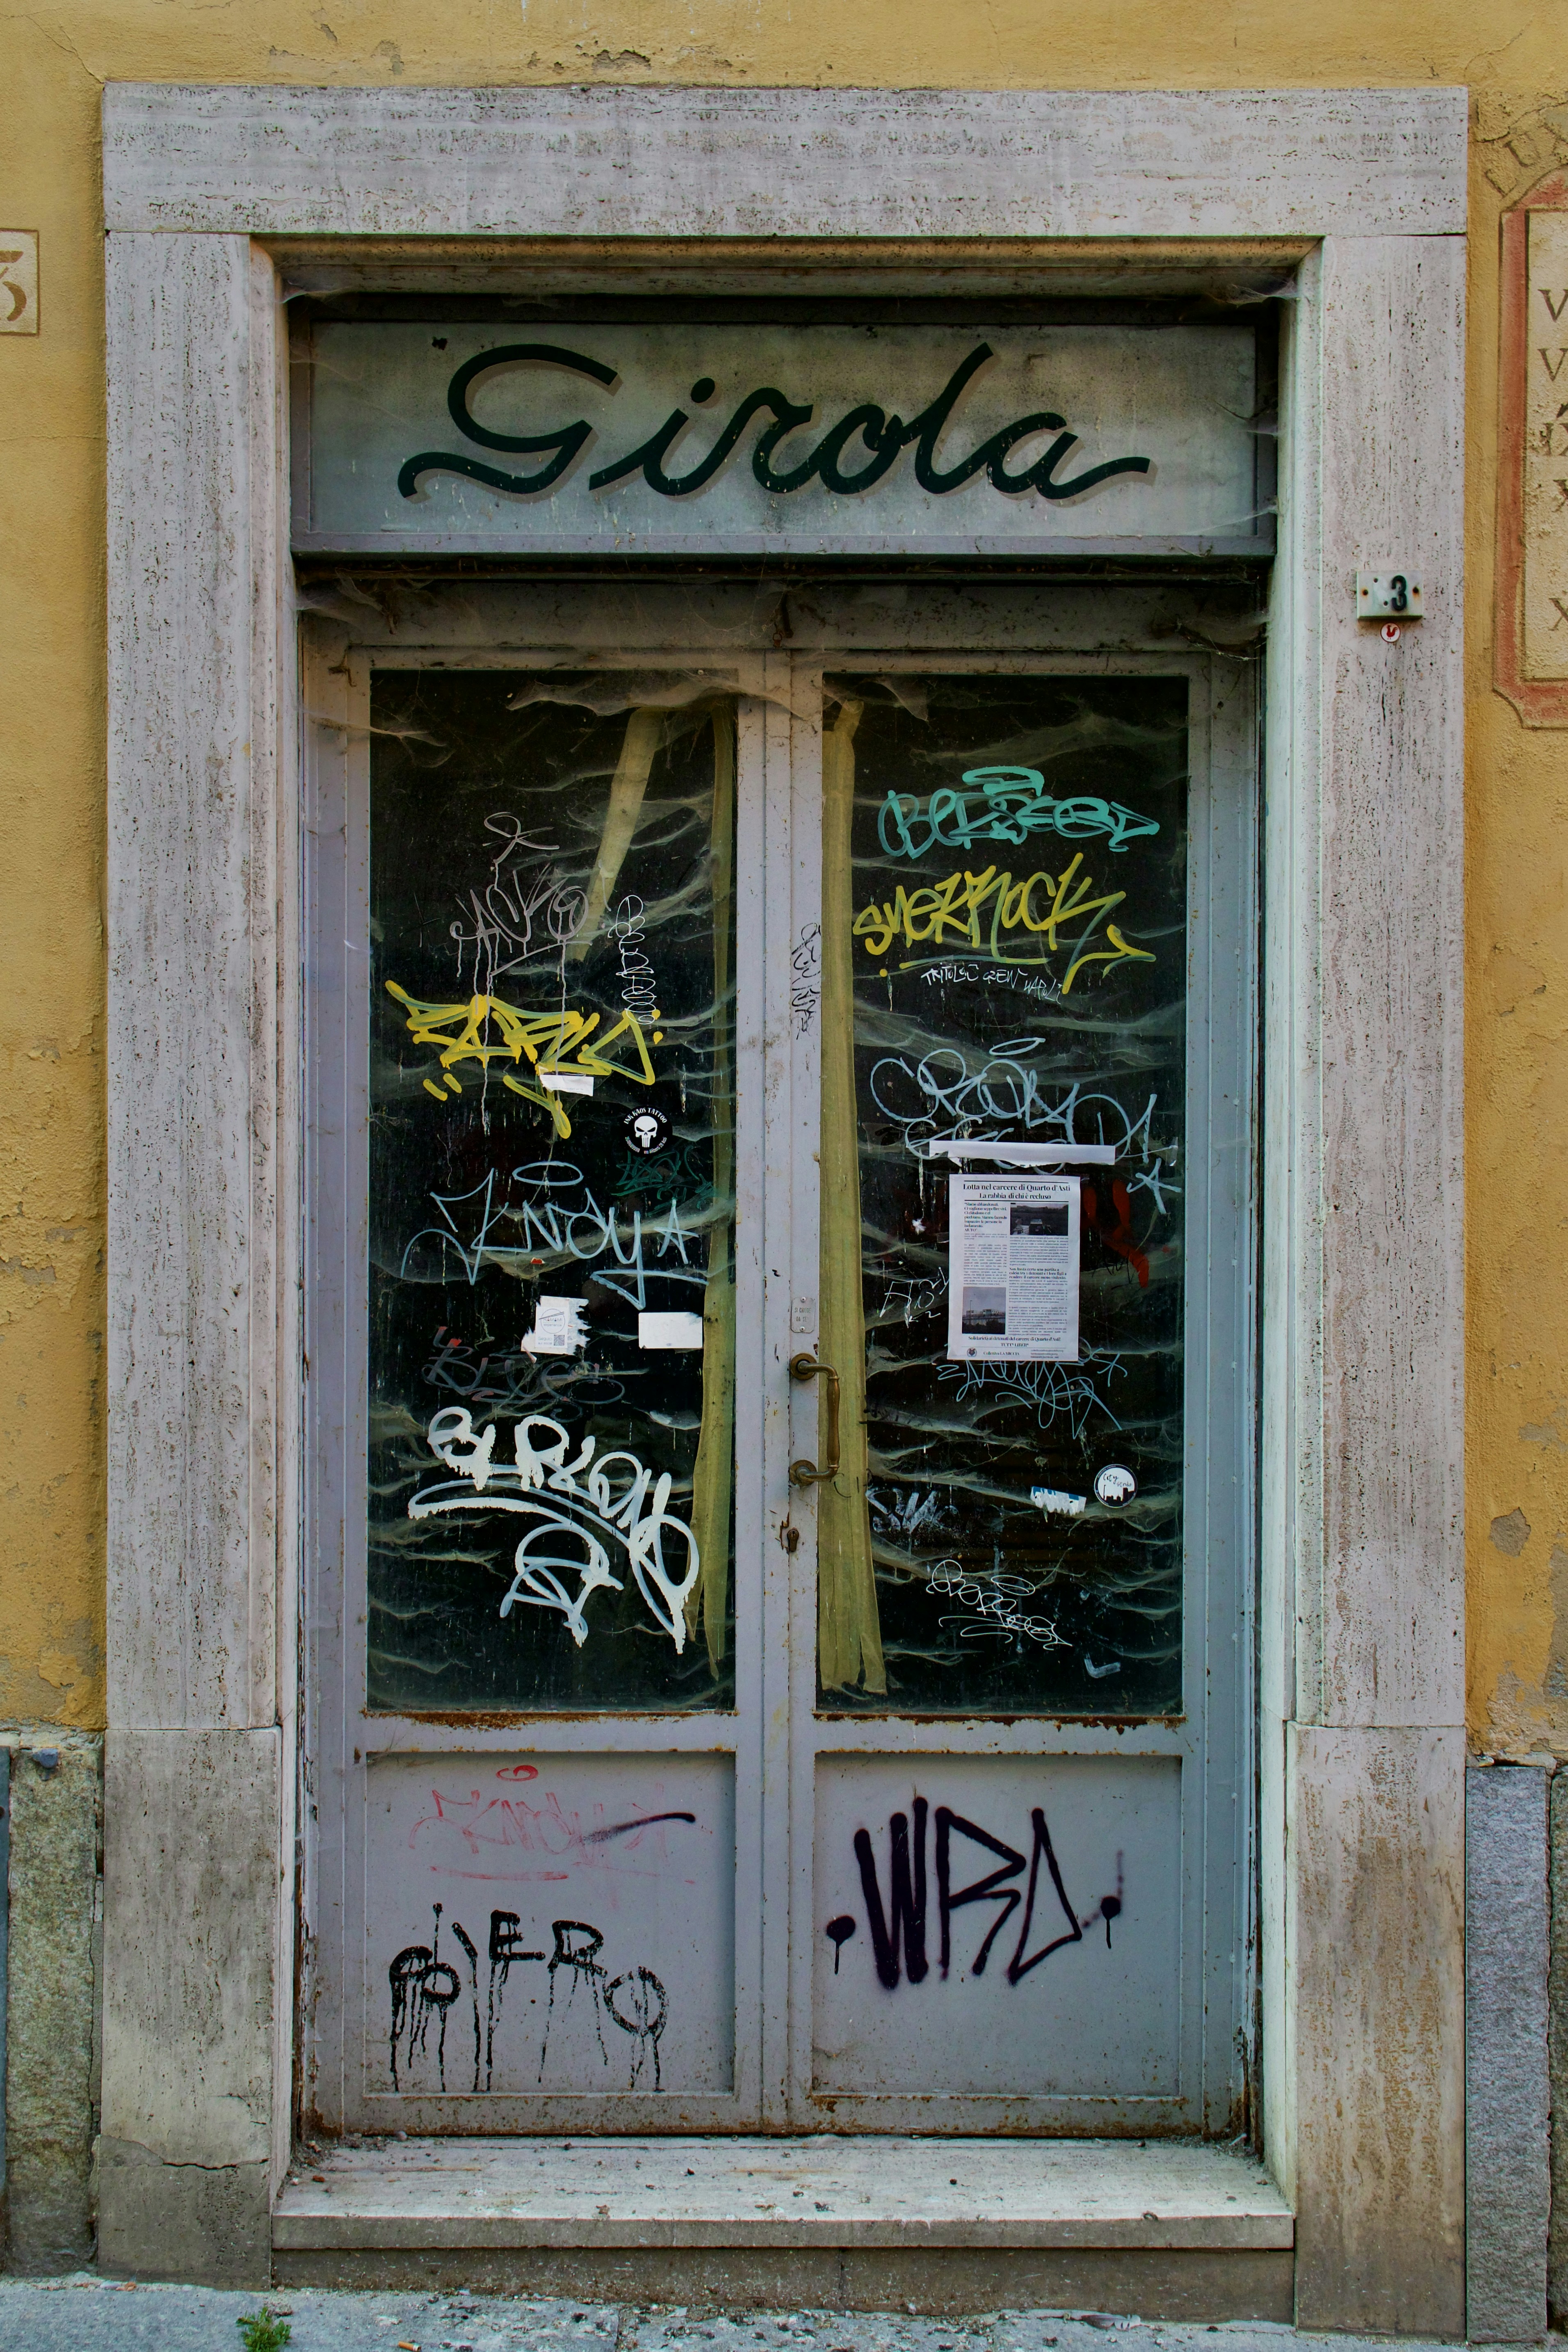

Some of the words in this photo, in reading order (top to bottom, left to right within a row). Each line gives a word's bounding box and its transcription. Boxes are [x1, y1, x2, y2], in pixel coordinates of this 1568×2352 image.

[398, 342, 1152, 500] Girola
[1392, 575, 1407, 611] 3
[623, 1114, 634, 1124] INK
[632, 1107, 646, 1116] KAOS
[648, 1108, 667, 1123] TATTOO
